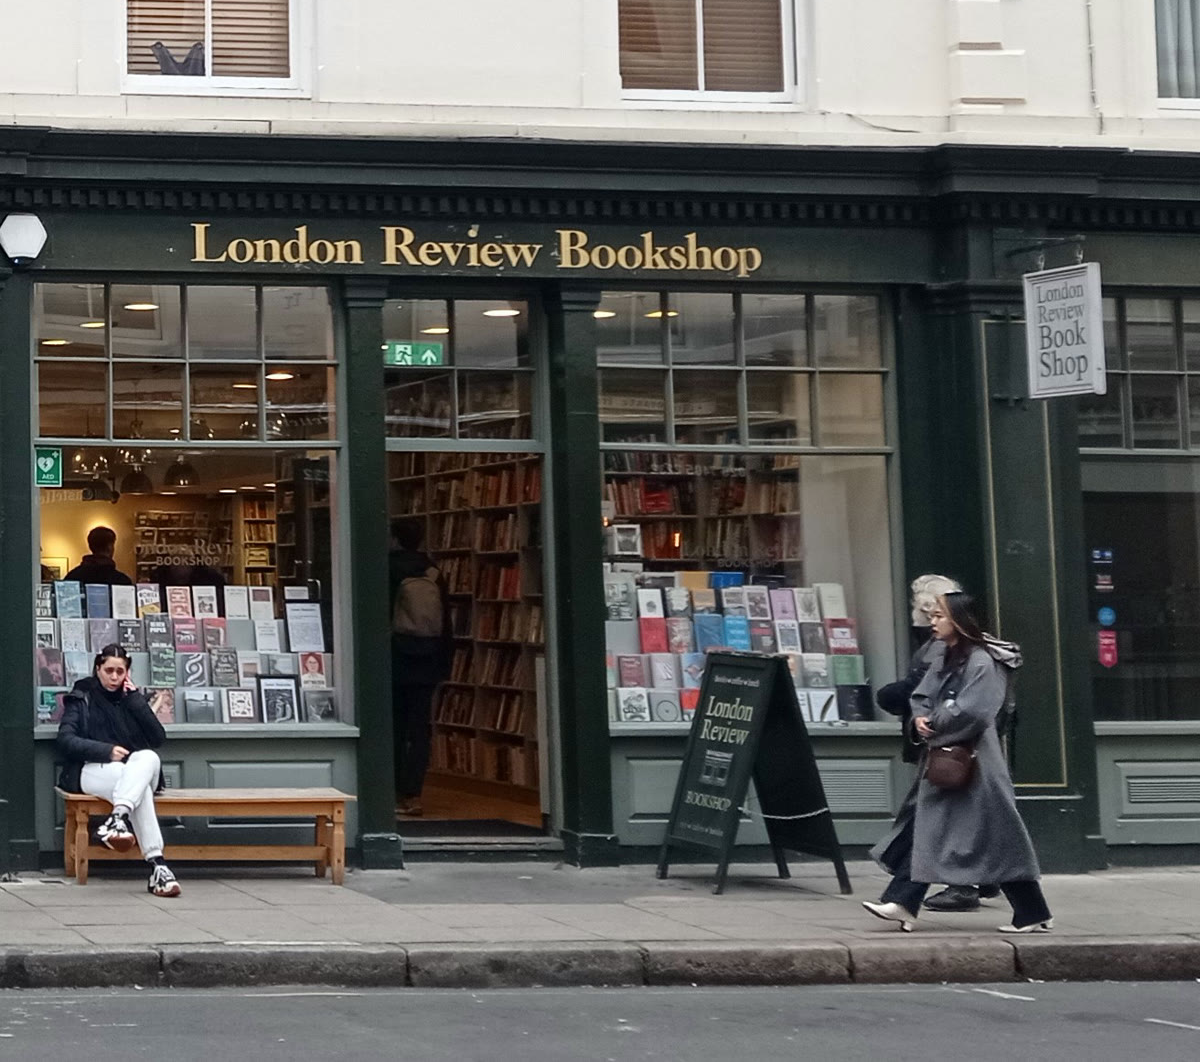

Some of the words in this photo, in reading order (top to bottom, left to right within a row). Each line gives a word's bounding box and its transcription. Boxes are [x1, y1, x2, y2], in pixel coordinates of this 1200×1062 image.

[190, 223, 365, 264] London
[379, 225, 543, 267] Review
[555, 229, 762, 278] Bookshop
[1036, 281, 1084, 304] London
[1037, 303, 1084, 324] Review
[1039, 319, 1087, 350] Book
[1040, 350, 1088, 381] Shop
[156, 556, 220, 566] BOOKSHOP
[705, 695, 753, 722] London
[700, 718, 750, 745] Review
[684, 790, 731, 811] BOOKSHOP
